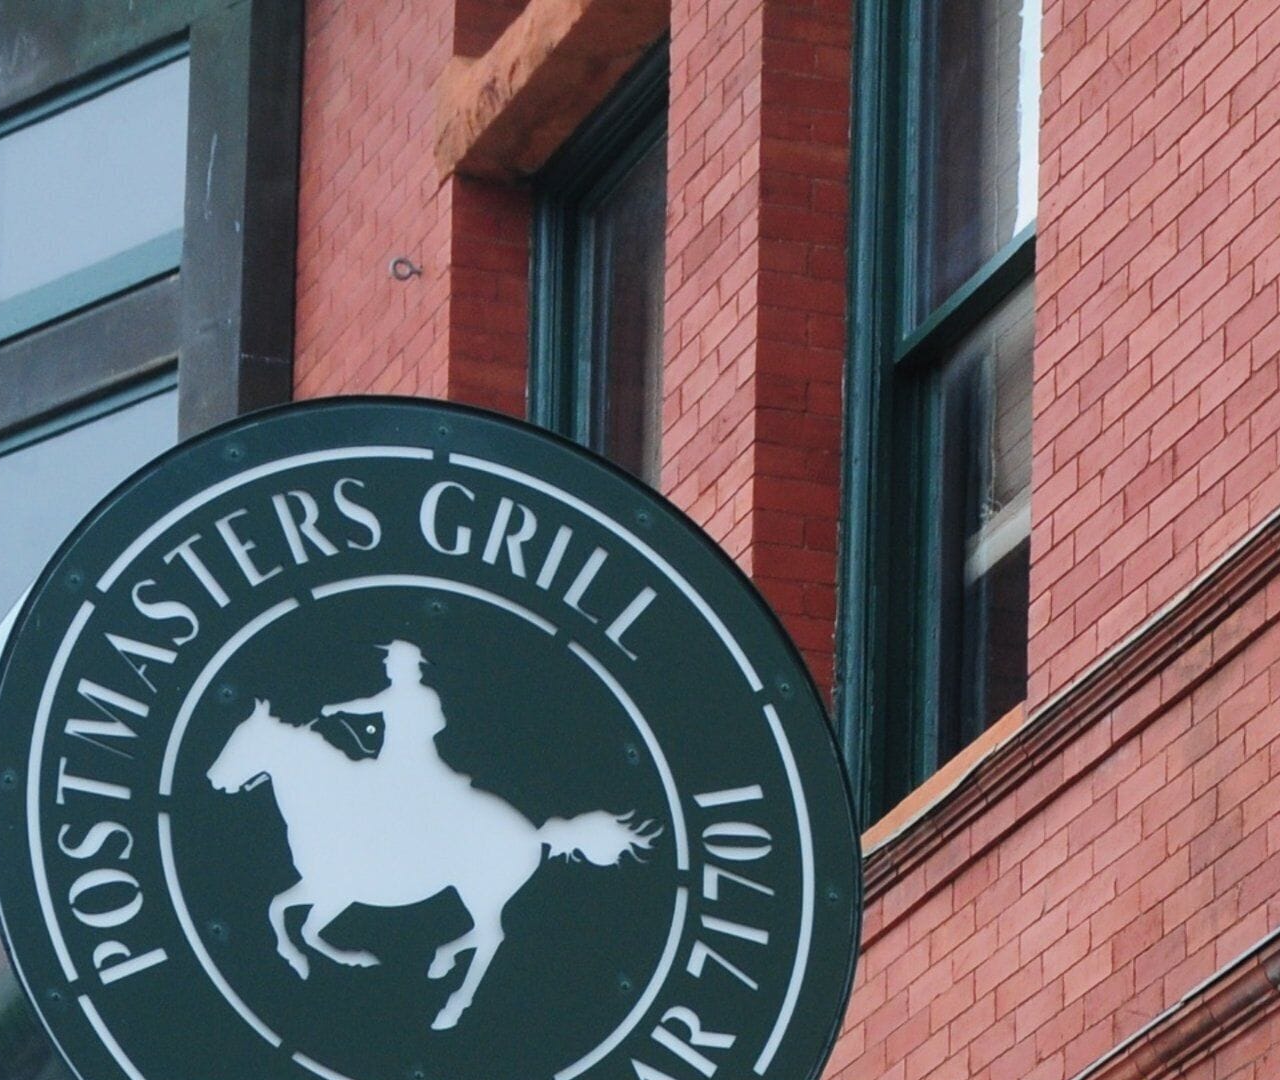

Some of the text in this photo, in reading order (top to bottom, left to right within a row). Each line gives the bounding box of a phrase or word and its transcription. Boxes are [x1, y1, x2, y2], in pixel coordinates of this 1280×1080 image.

[55, 476, 659, 987] POSTMASTERS GRILL
[685, 783, 775, 992] 71701
